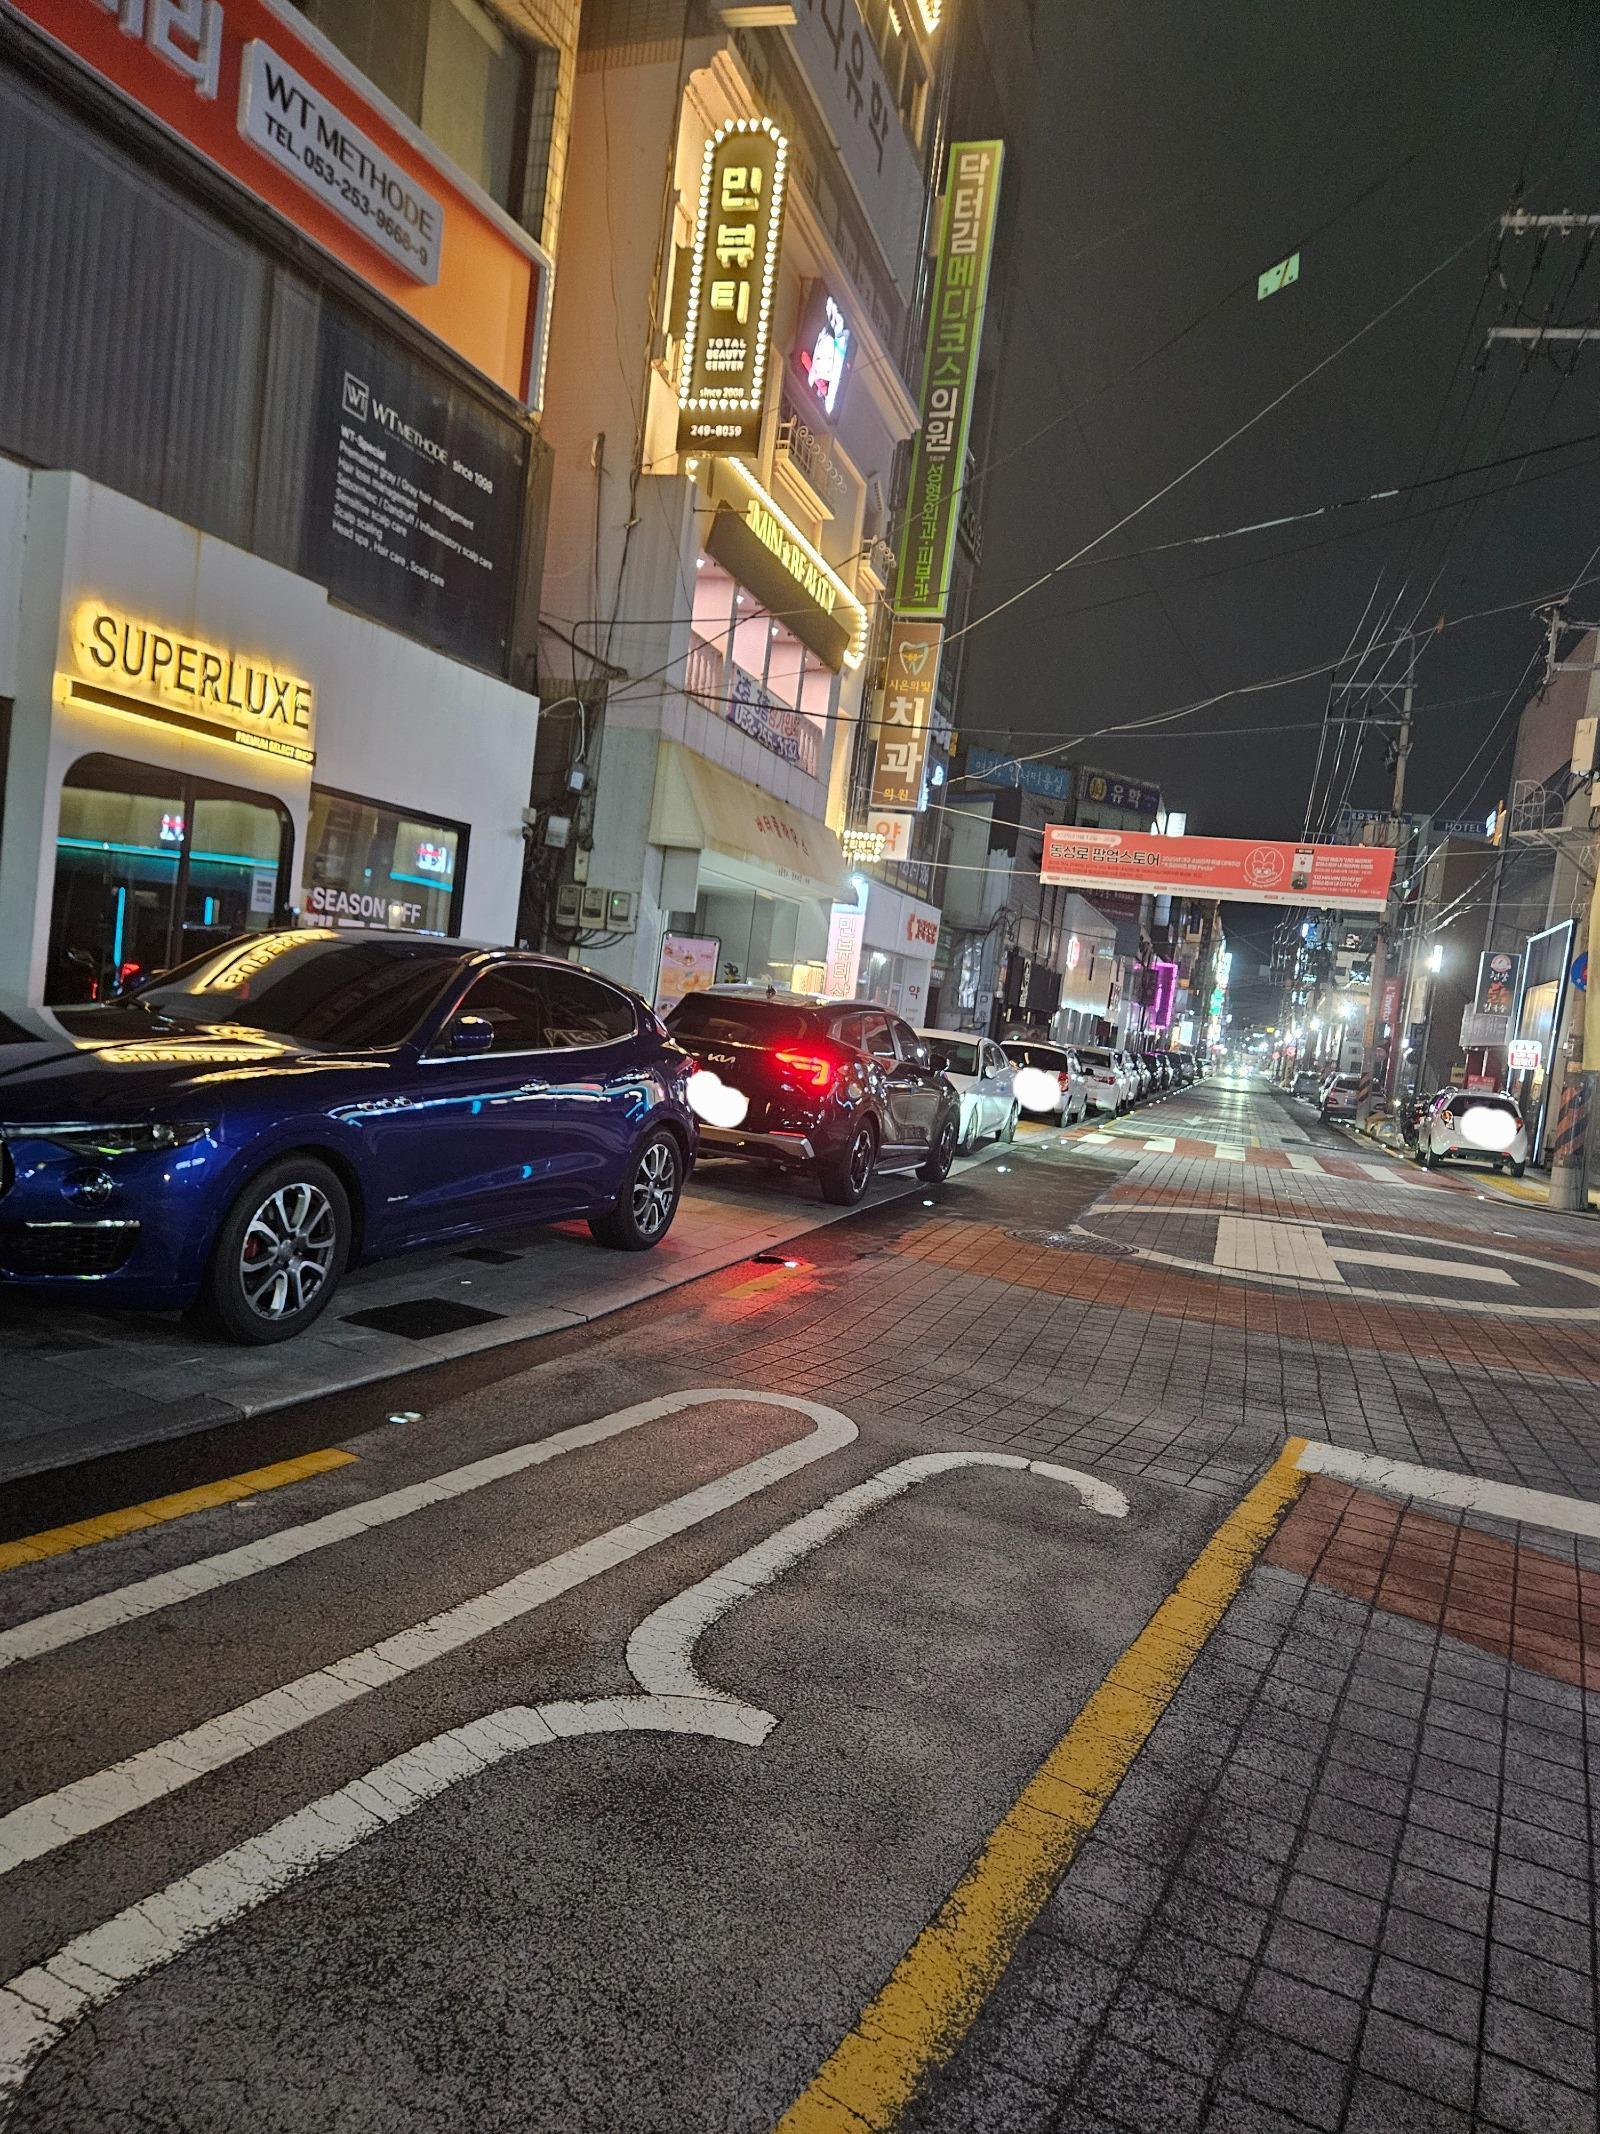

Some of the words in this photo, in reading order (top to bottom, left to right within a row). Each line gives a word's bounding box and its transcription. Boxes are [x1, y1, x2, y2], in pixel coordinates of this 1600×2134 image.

[264, 61, 316, 130] WT
[316, 114, 434, 242] METHODE
[710, 166, 763, 325] 민뷰티
[708, 338, 747, 349] TOTAL
[705, 348, 747, 360] BEAUTY
[704, 360, 745, 372] CENTER
[690, 424, 742, 438] 249-8059
[372, 398, 399, 431] WT
[398, 420, 448, 466] METHODE
[452, 460, 474, 482] since
[89, 615, 313, 730] SUPERLUXE
[880, 695, 926, 784] 치과
[883, 788, 910, 801] 의원
[876, 821, 902, 852] 약
[1445, 822, 1482, 834] HOTEL
[1049, 843, 1089, 860] 동성로
[312, 886, 387, 920] SEASON
[908, 985, 921, 999] 약
